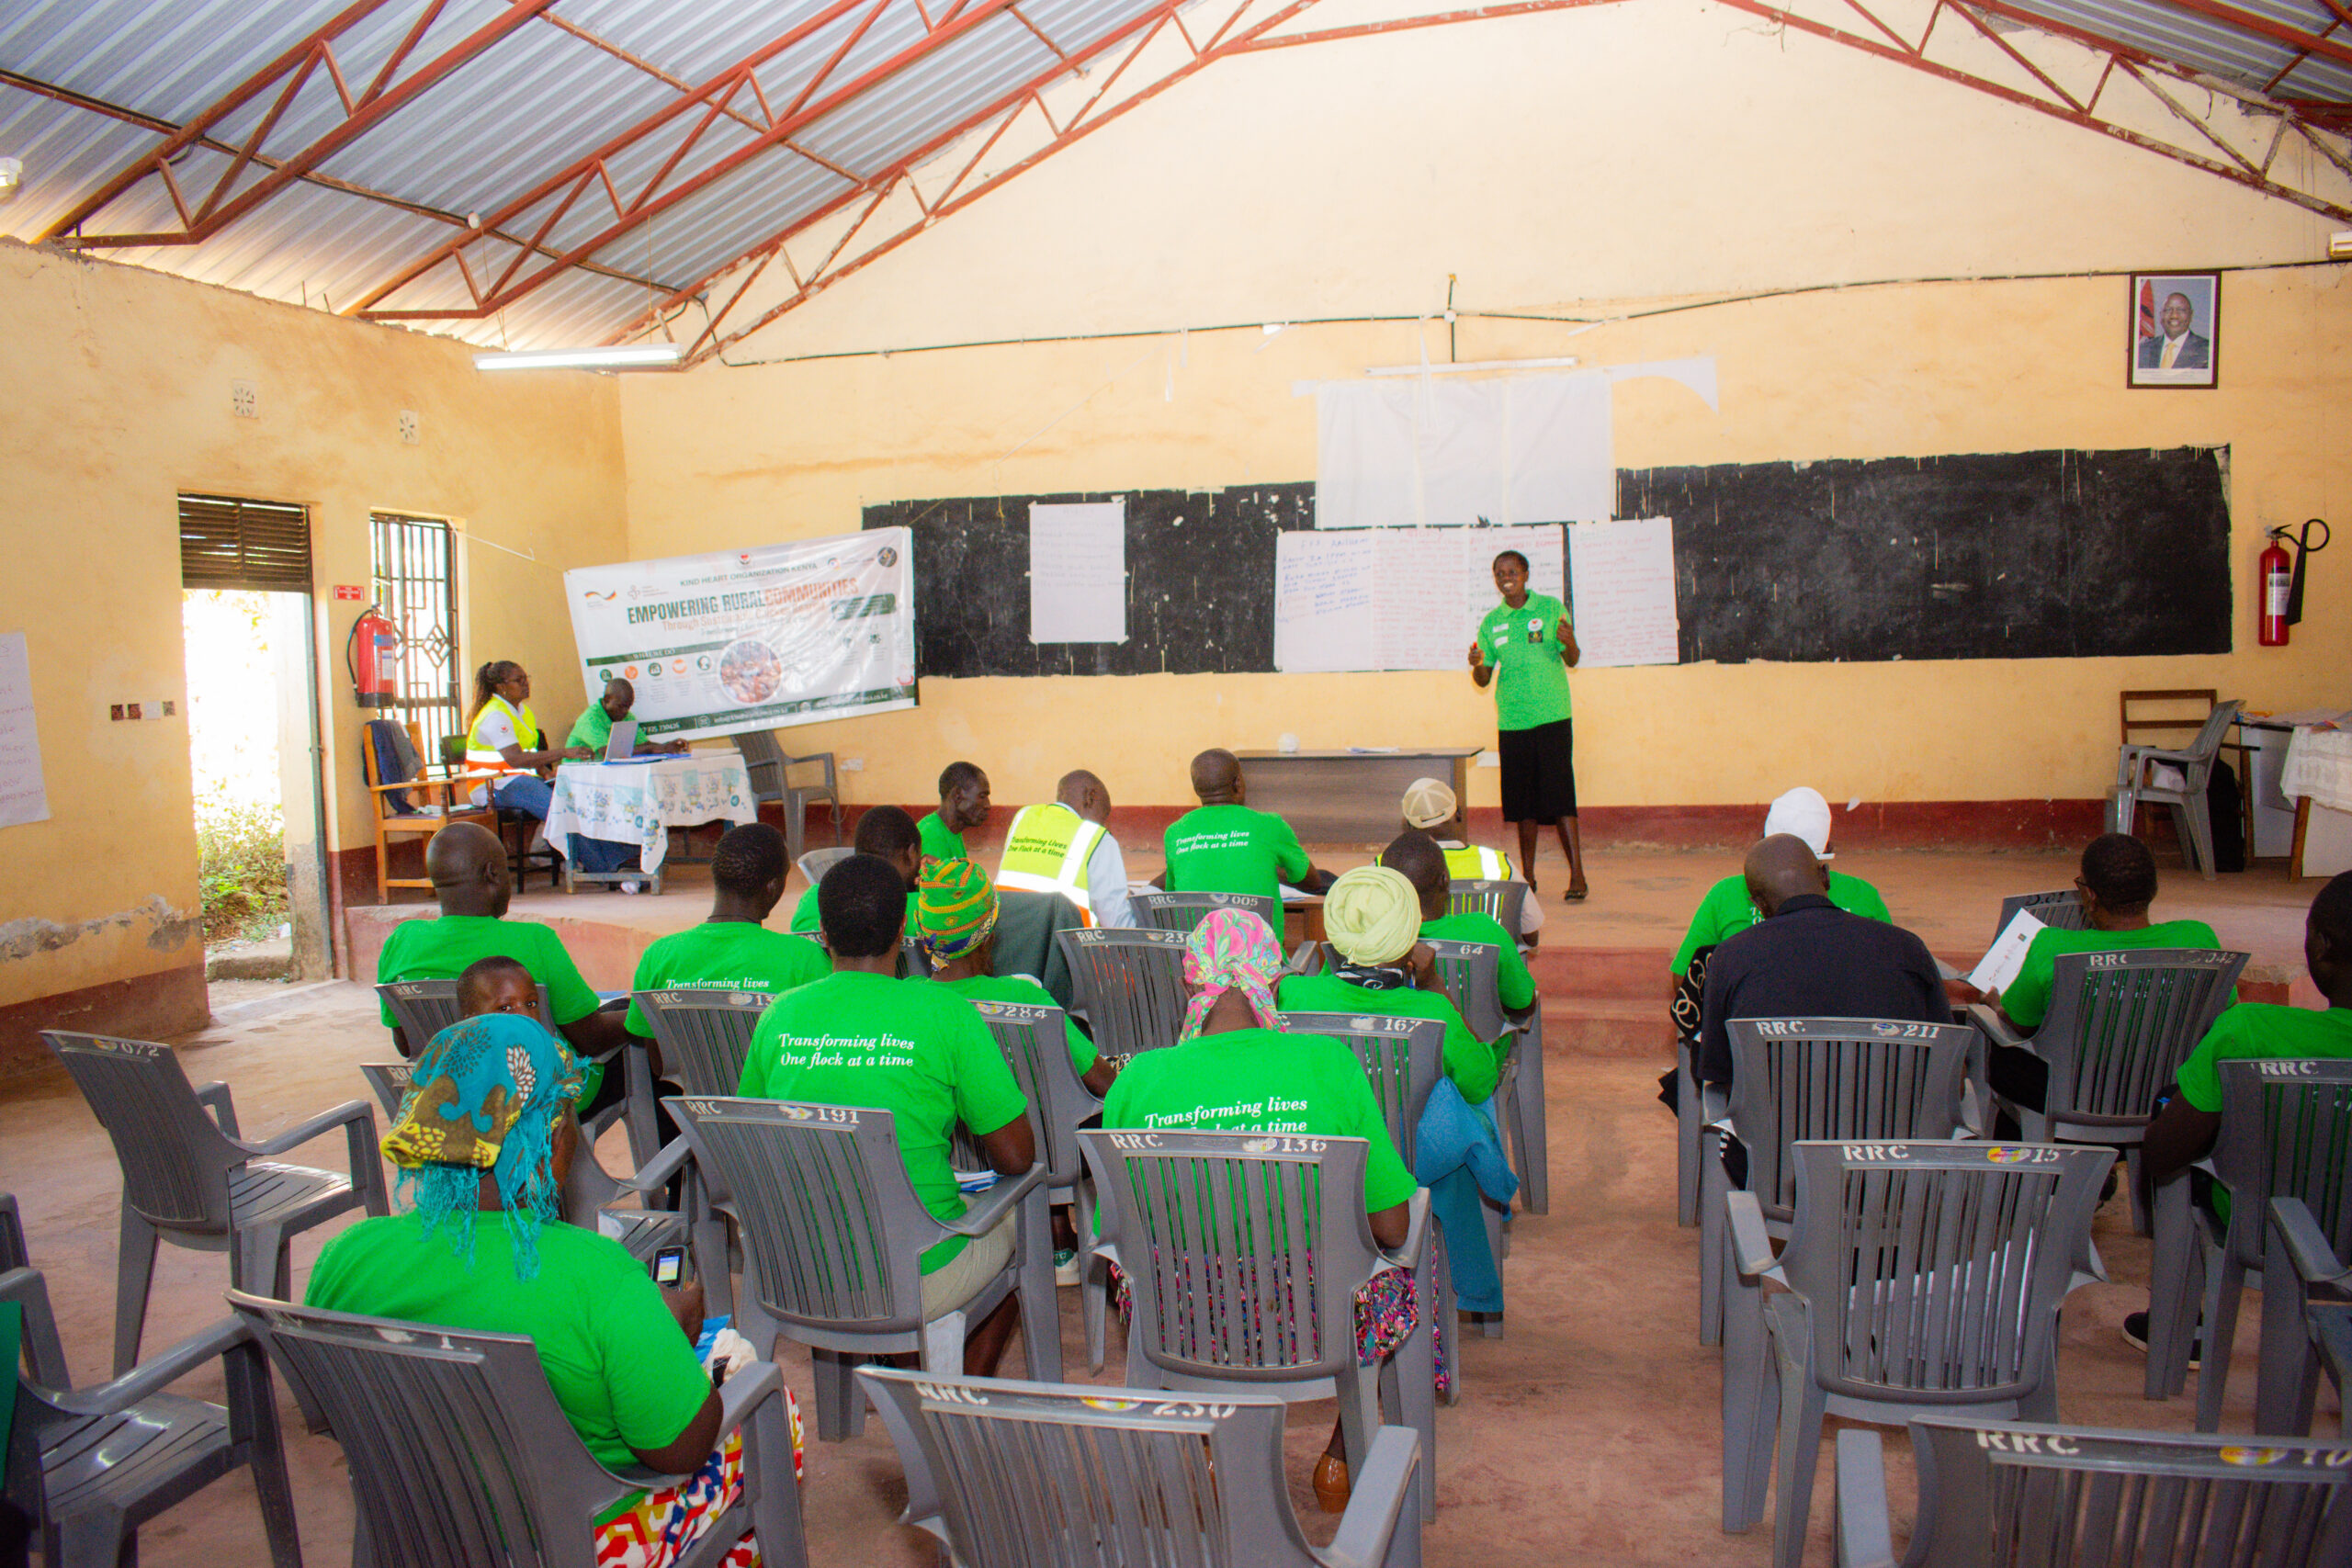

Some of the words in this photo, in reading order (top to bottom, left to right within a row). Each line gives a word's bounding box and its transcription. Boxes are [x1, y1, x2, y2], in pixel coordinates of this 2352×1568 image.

[627, 595, 719, 625] EMPOWERING
[1177, 831, 1228, 847] Transforming
[1229, 829, 1250, 839] lives
[1210, 841, 1220, 850] at
[1228, 839, 1249, 848] time
[1148, 895, 1177, 906] RRC
[1231, 895, 1259, 907] 005
[1075, 929, 1106, 944] RRC
[1164, 931, 1187, 944] 23
[393, 984, 423, 996] RRC
[742, 976, 770, 988] lives
[650, 991, 683, 1005] RRC
[1004, 1005, 1048, 1020] 284
[1383, 1017, 1423, 1033] 167
[1756, 1020, 1806, 1036] RRC
[1903, 1023, 1940, 1039] 211
[777, 1032, 877, 1052] Transforming
[880, 1032, 915, 1051] lives
[780, 1051, 807, 1066] One
[806, 1051, 843, 1070] flock
[847, 1055, 862, 1067] at
[865, 1056, 876, 1066] a
[879, 1052, 914, 1067] time
[2259, 1060, 2319, 1076] RRC
[684, 1100, 723, 1115] RRC
[818, 1107, 861, 1124] 191
[1144, 1099, 1263, 1130] Transforming
[1267, 1096, 1308, 1112] lives
[1267, 1117, 1308, 1133] time
[1109, 1133, 1163, 1149] RRC
[1281, 1137, 1328, 1153] 136
[1842, 1145, 1910, 1161] RRC
[1975, 1428, 2080, 1456] RRC
